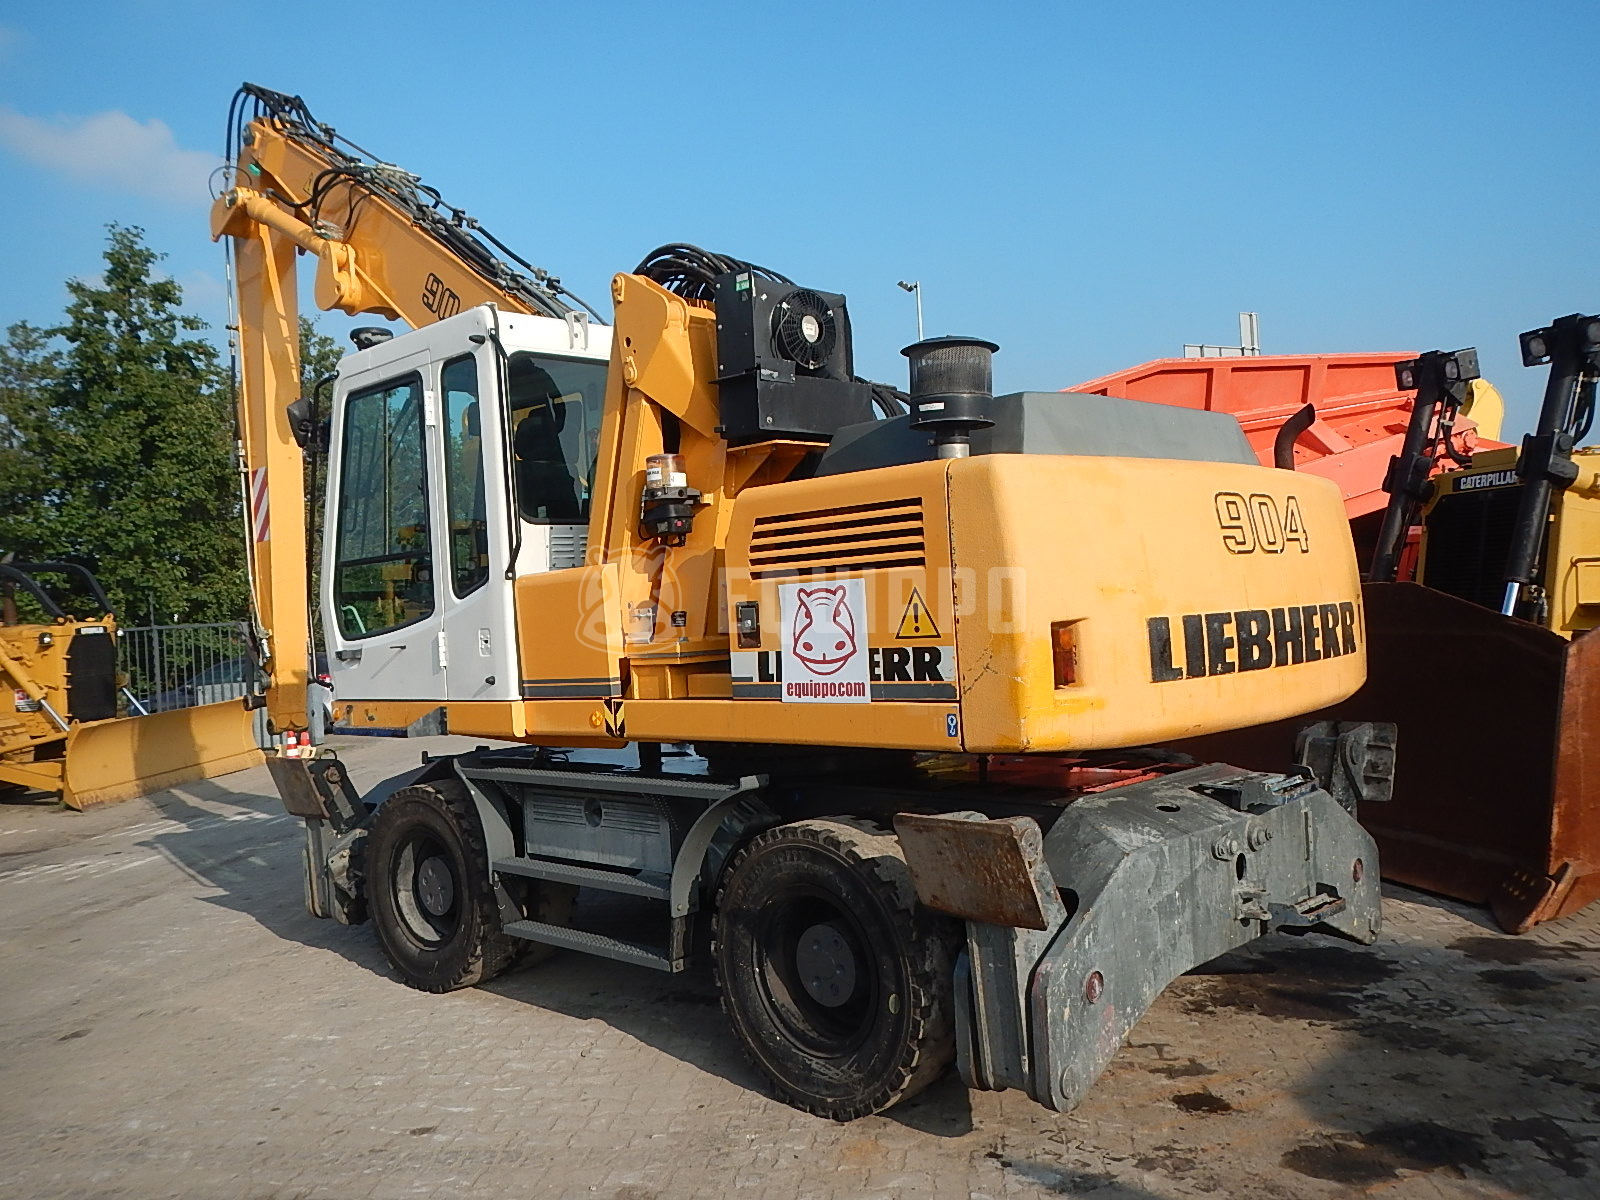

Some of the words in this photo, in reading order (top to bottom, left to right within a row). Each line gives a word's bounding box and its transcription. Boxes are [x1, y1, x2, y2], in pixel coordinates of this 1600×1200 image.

[1214, 491, 1309, 554] 904
[758, 646, 945, 683] LIERR
[1146, 601, 1357, 683] LIEBHERR
[786, 680, 866, 698] equippo.com
